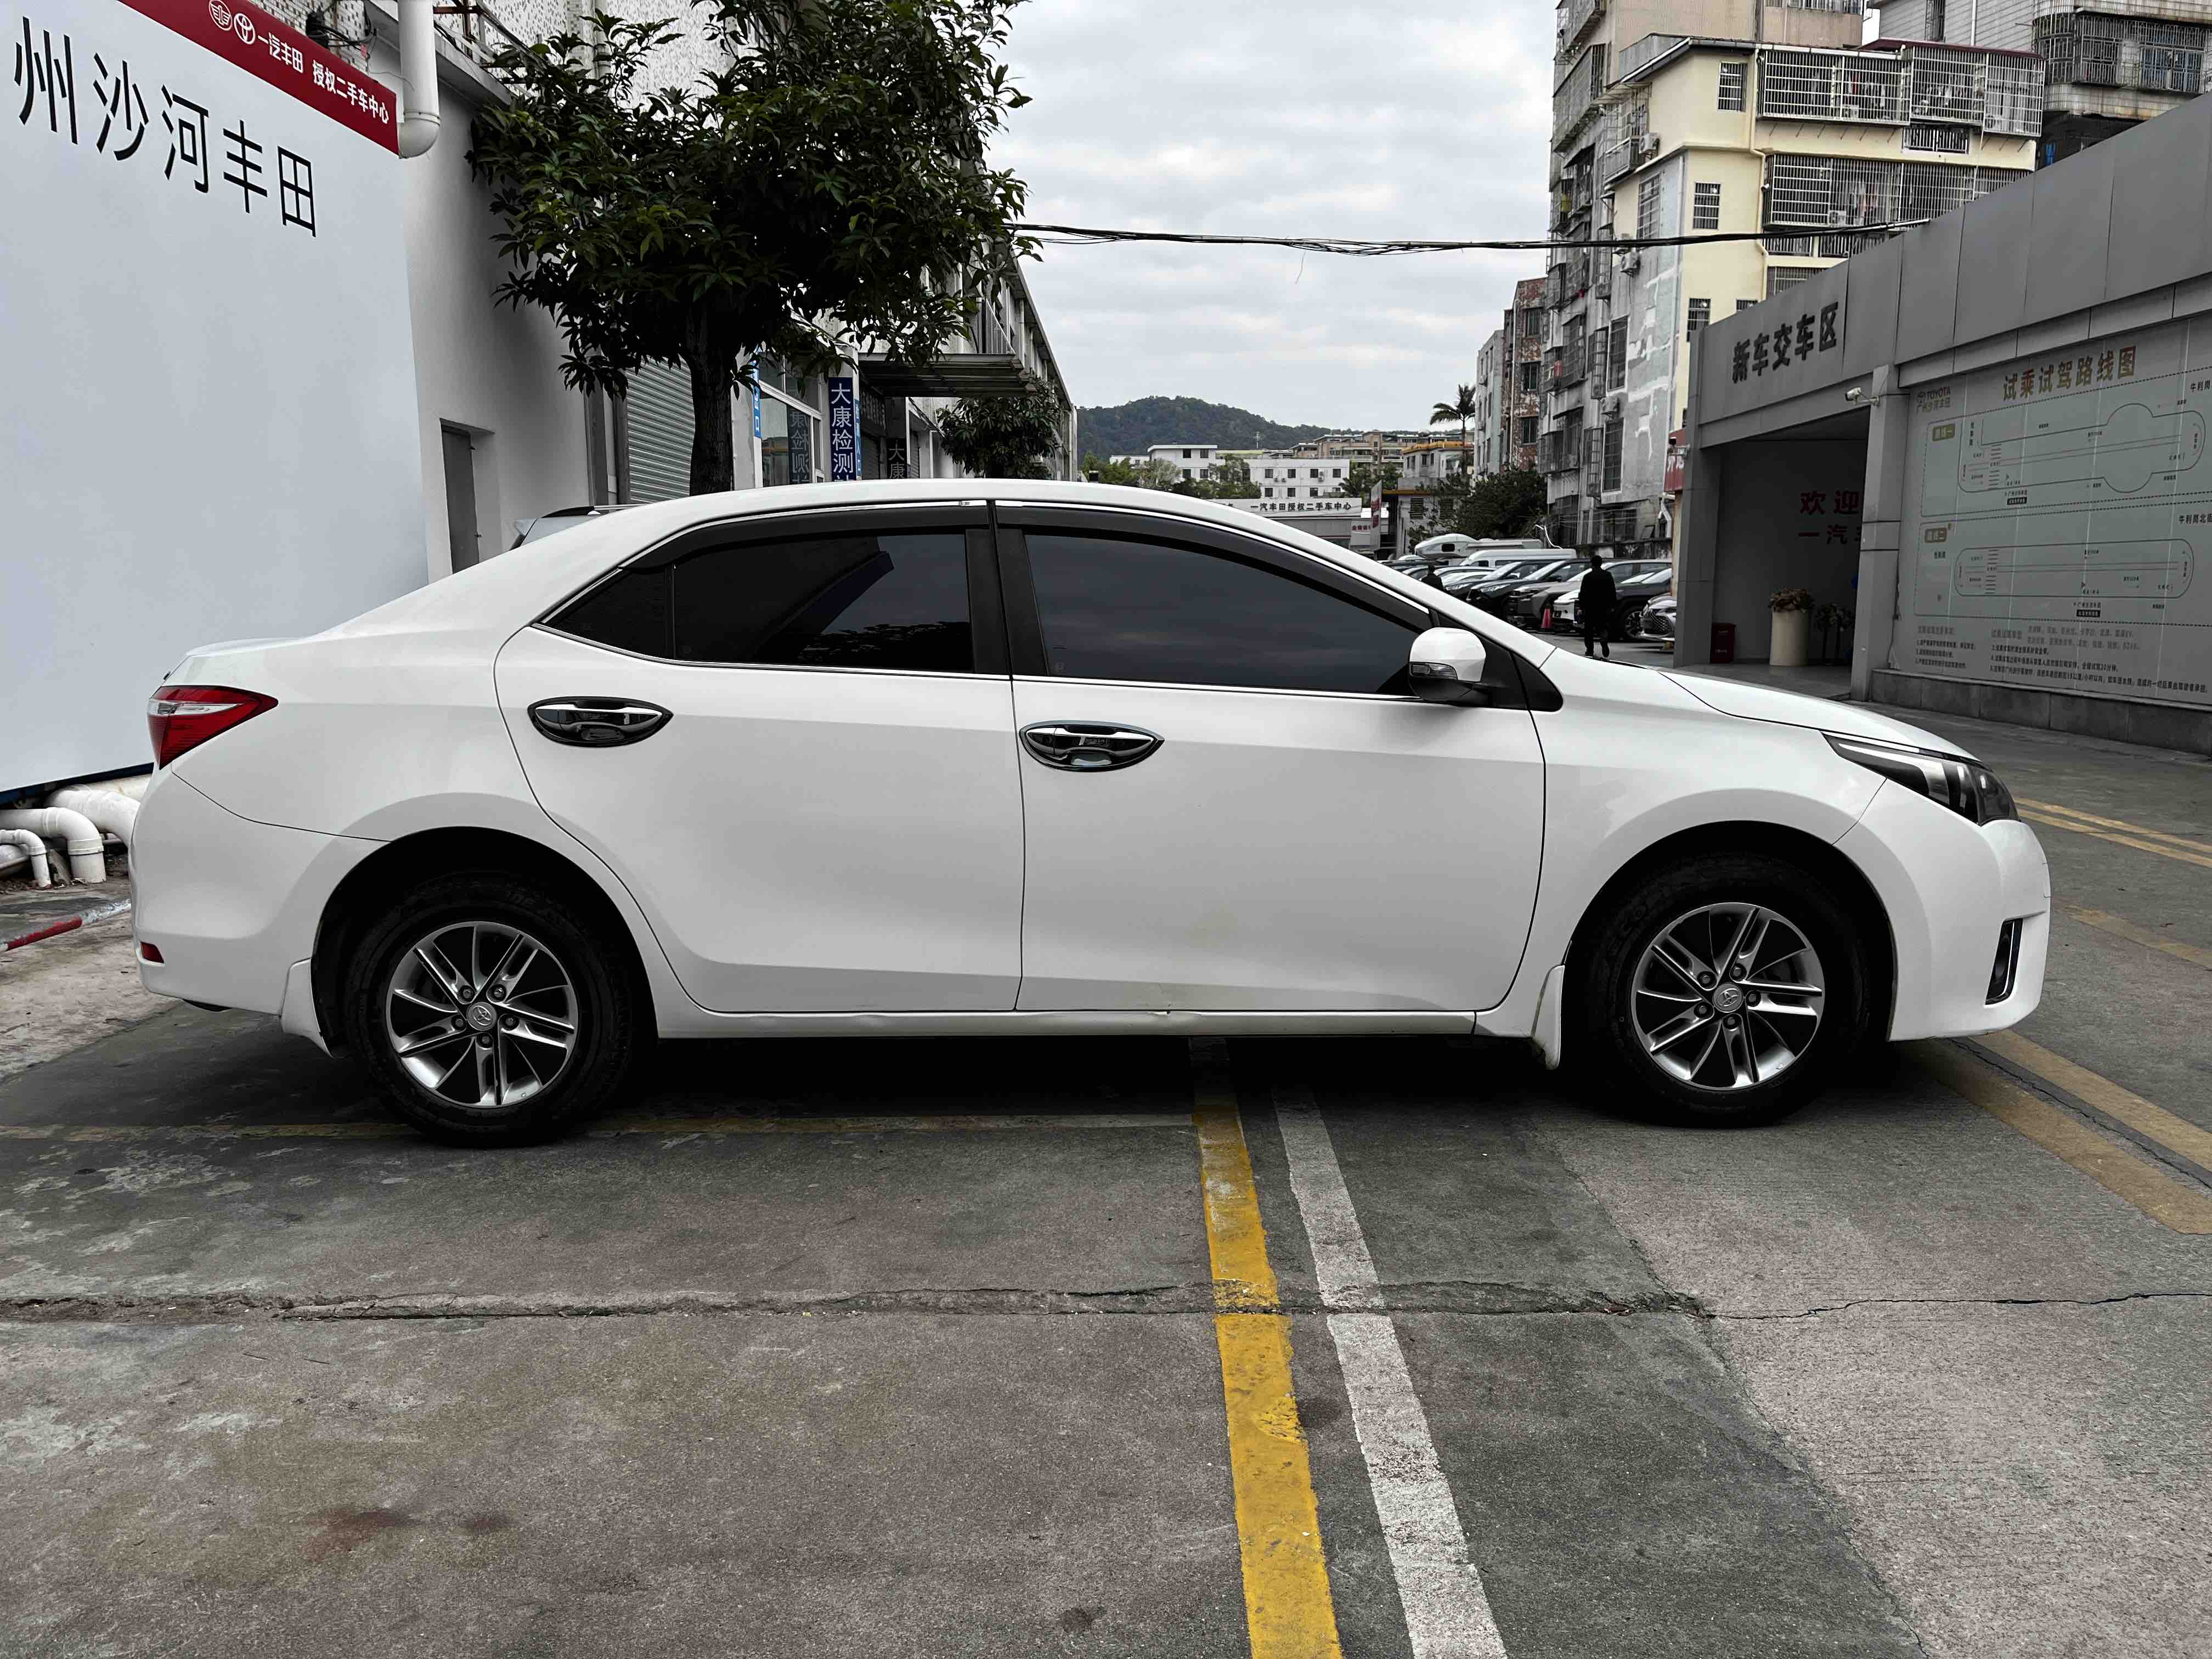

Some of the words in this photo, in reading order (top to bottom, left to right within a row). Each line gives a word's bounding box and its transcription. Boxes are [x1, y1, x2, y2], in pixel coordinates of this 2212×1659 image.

[258, 32, 303, 74] 一汽丰田
[312, 59, 390, 125] 授权二手车中心
[13, 16, 317, 238] 州沙河丰田
[1732, 302, 1839, 384] 新车交车区
[1927, 386, 1951, 399] TOYOTA
[2003, 346, 2136, 401] 试乘试驾路线图
[1250, 501, 1352, 512] 一汽丰田授权二手车中心
[1799, 490, 1860, 515] 欢迎
